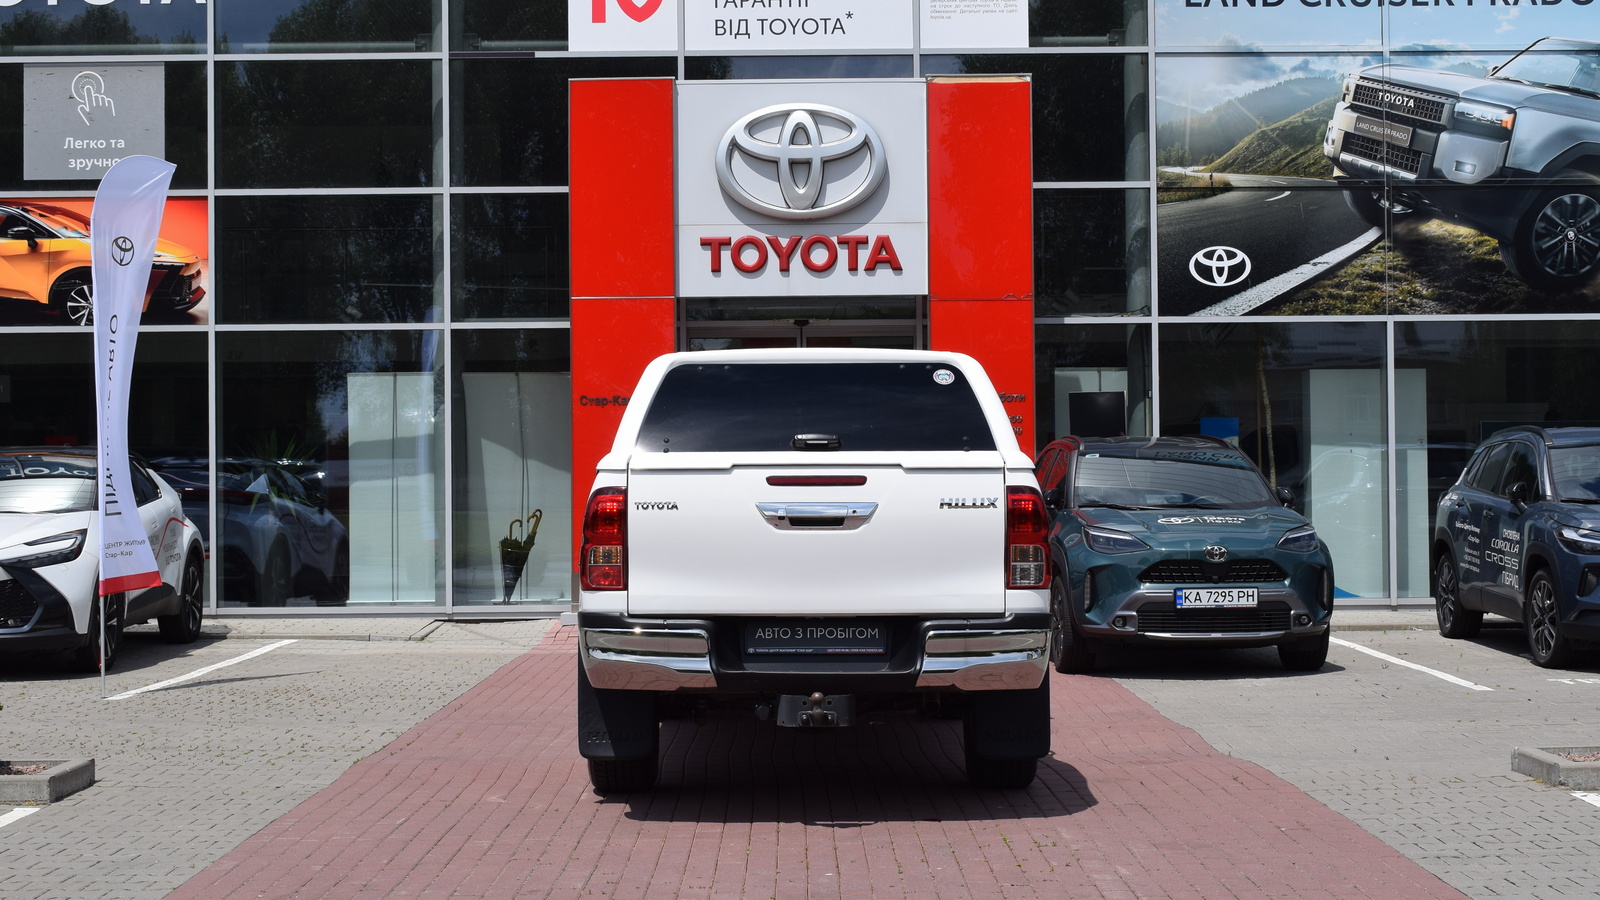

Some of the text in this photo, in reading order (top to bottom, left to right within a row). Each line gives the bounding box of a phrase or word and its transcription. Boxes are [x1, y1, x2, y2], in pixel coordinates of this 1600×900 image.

[715, 19, 751, 39] ВІД
[1379, 92, 1414, 108] TOYOTA
[1356, 121, 1408, 140] LAND CRUISER PRADO
[64, 137, 125, 149] Легко та
[699, 234, 903, 273] TOYOTA
[634, 501, 679, 511] TOYOTA
[939, 497, 999, 509] HILUX
[104, 541, 123, 549] ЦЕНТР
[1491, 538, 1520, 553] COROLLA
[105, 550, 133, 559] Стар-Кар
[1485, 550, 1519, 570] CROSS
[1184, 590, 1255, 603] KA 7295 PH
[755, 627, 791, 639] АВТО
[807, 627, 879, 639] ПРОБІГОМ
